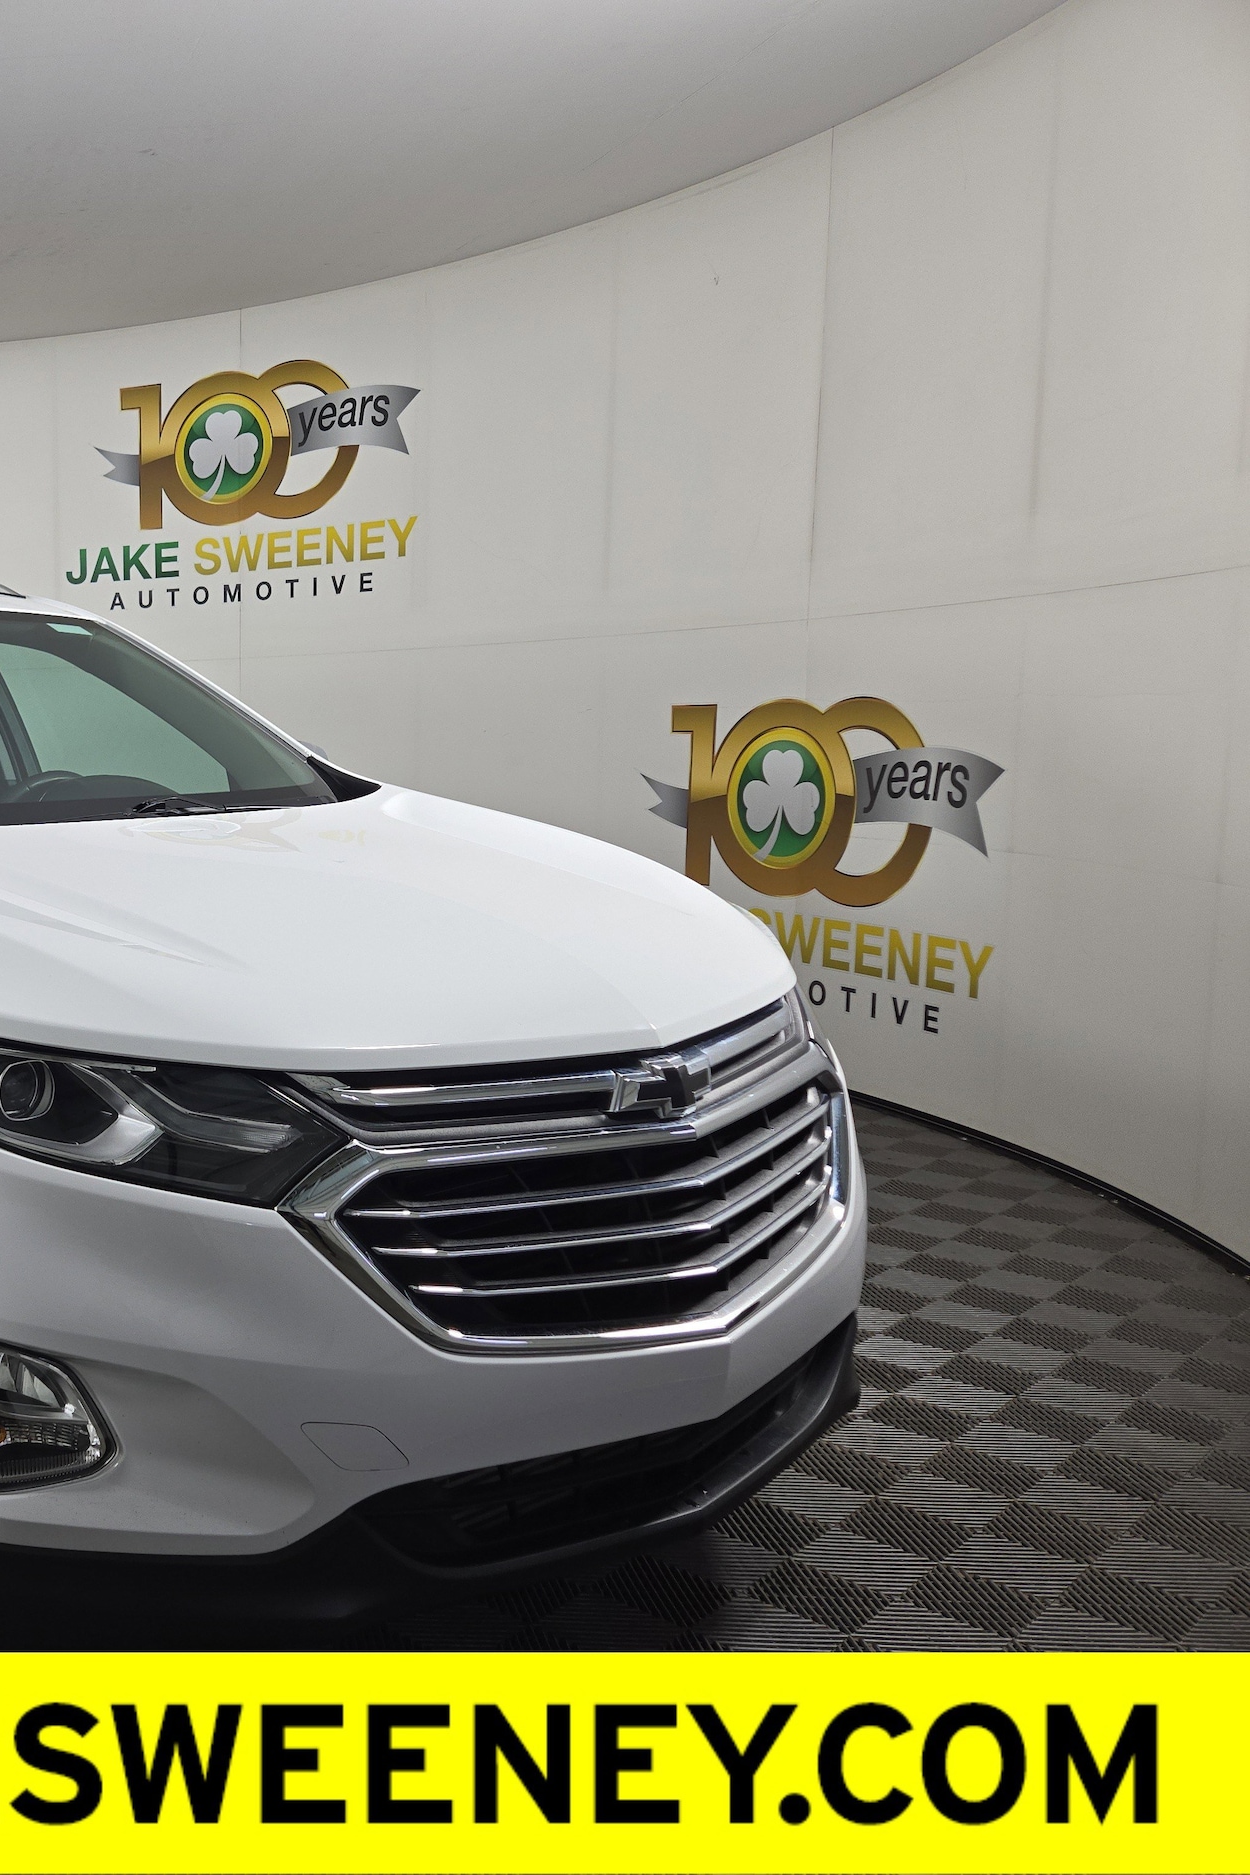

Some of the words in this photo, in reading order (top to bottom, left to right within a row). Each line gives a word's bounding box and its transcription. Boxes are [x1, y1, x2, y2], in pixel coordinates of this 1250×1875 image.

[120, 359, 359, 530] 100
[298, 394, 391, 447] years
[66, 541, 180, 585] JAKE
[194, 516, 419, 577] SWEENEY
[110, 572, 374, 611] AUTOMOTIVE
[671, 696, 933, 908] 100
[863, 759, 971, 814] years
[808, 980, 940, 1034] OTIVE
